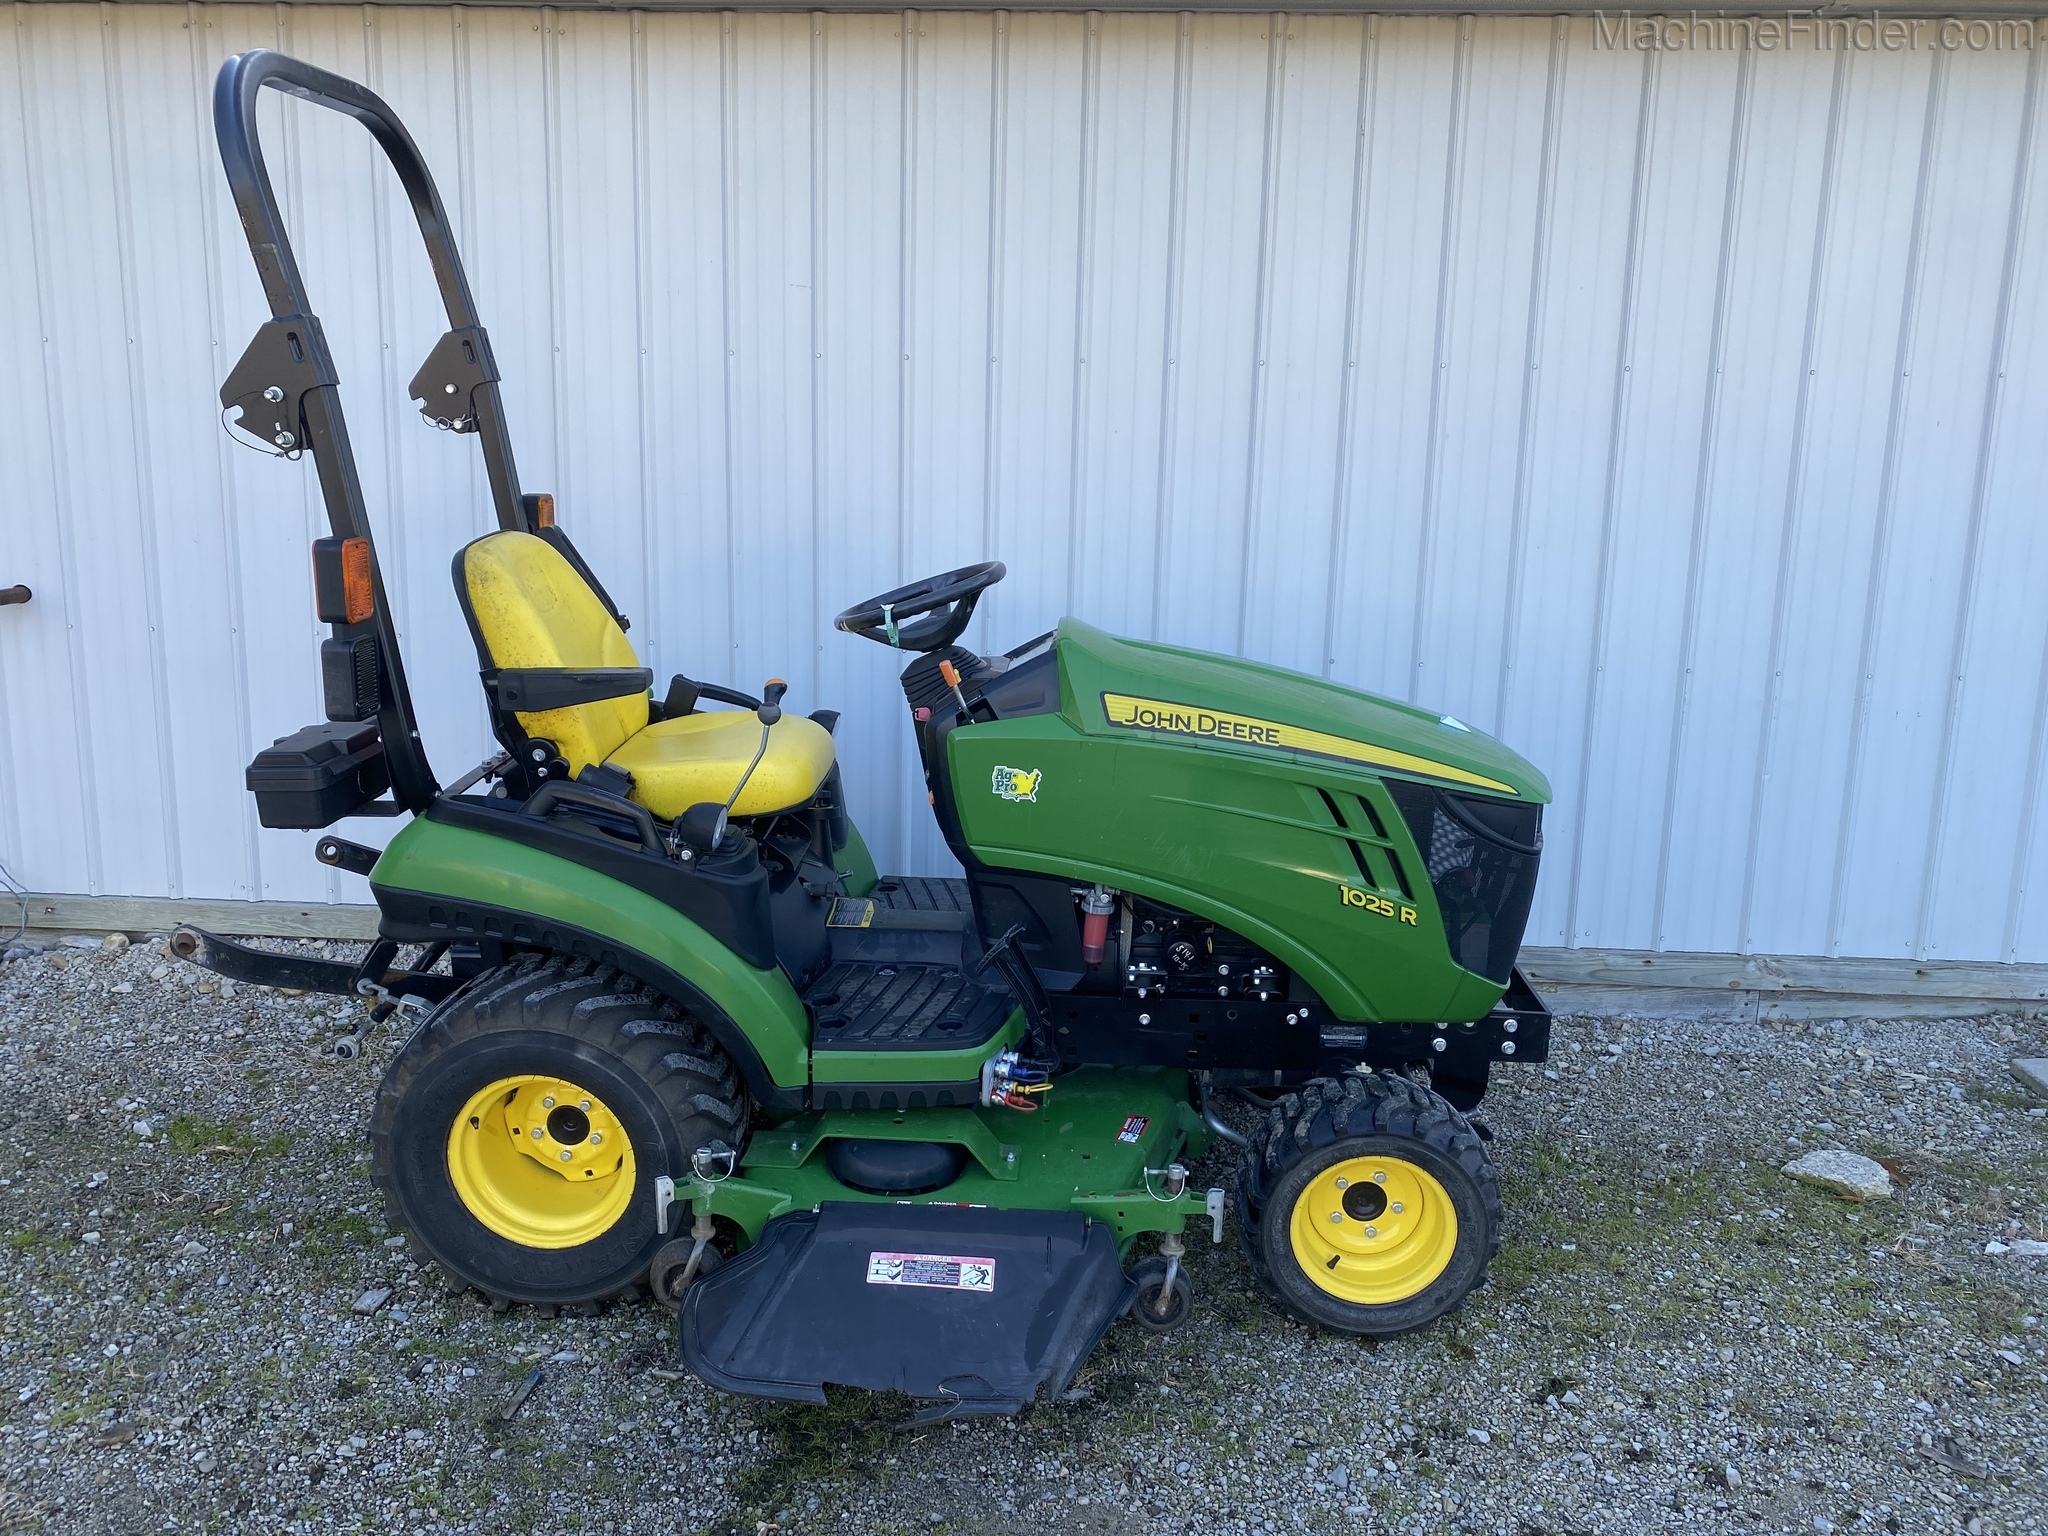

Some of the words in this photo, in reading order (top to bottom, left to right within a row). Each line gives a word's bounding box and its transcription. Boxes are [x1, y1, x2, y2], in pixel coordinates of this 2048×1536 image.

[1124, 705, 1191, 731] JOHN
[1198, 713, 1280, 744] DEERE
[995, 780, 1018, 792] Pro
[1339, 884, 1395, 917] 1025
[1400, 905, 1417, 926] R
[922, 1254, 952, 1263] DANGER
